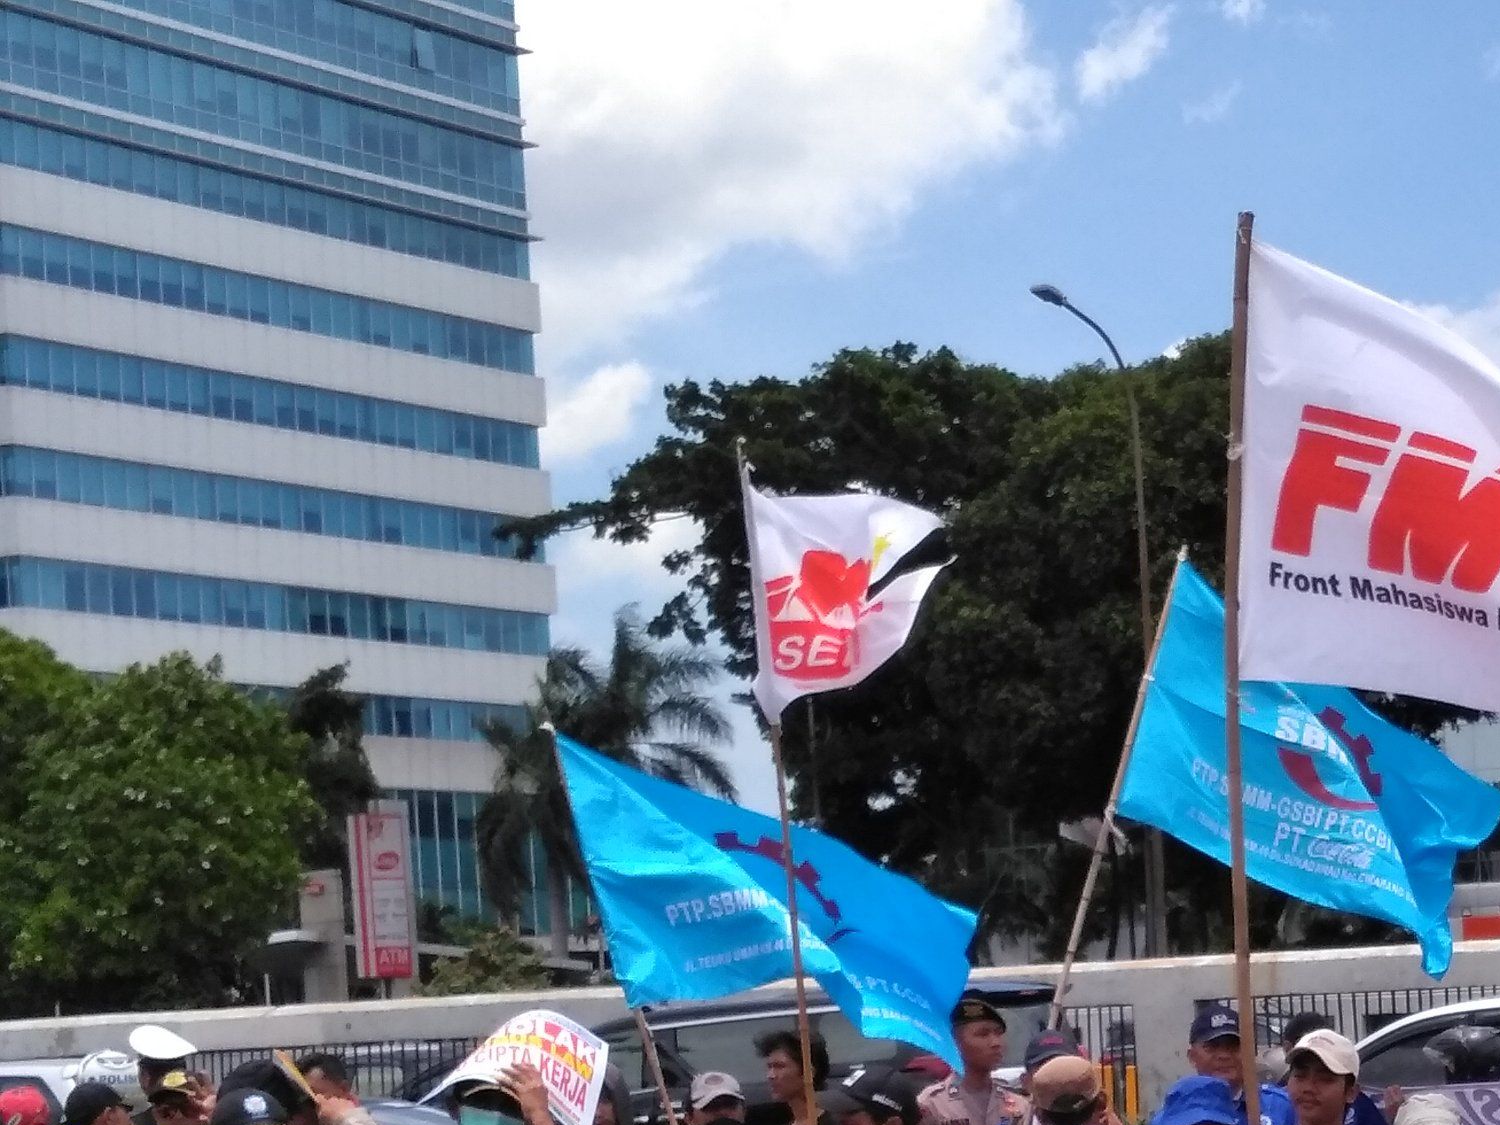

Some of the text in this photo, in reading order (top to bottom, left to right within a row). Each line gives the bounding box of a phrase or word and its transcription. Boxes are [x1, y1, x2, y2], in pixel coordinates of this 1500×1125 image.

[1269, 562, 1341, 597] Front
[1350, 576, 1489, 627] Mahasiswa
[380, 950, 411, 965] ATM
[540, 1053, 589, 1112] KERJA
